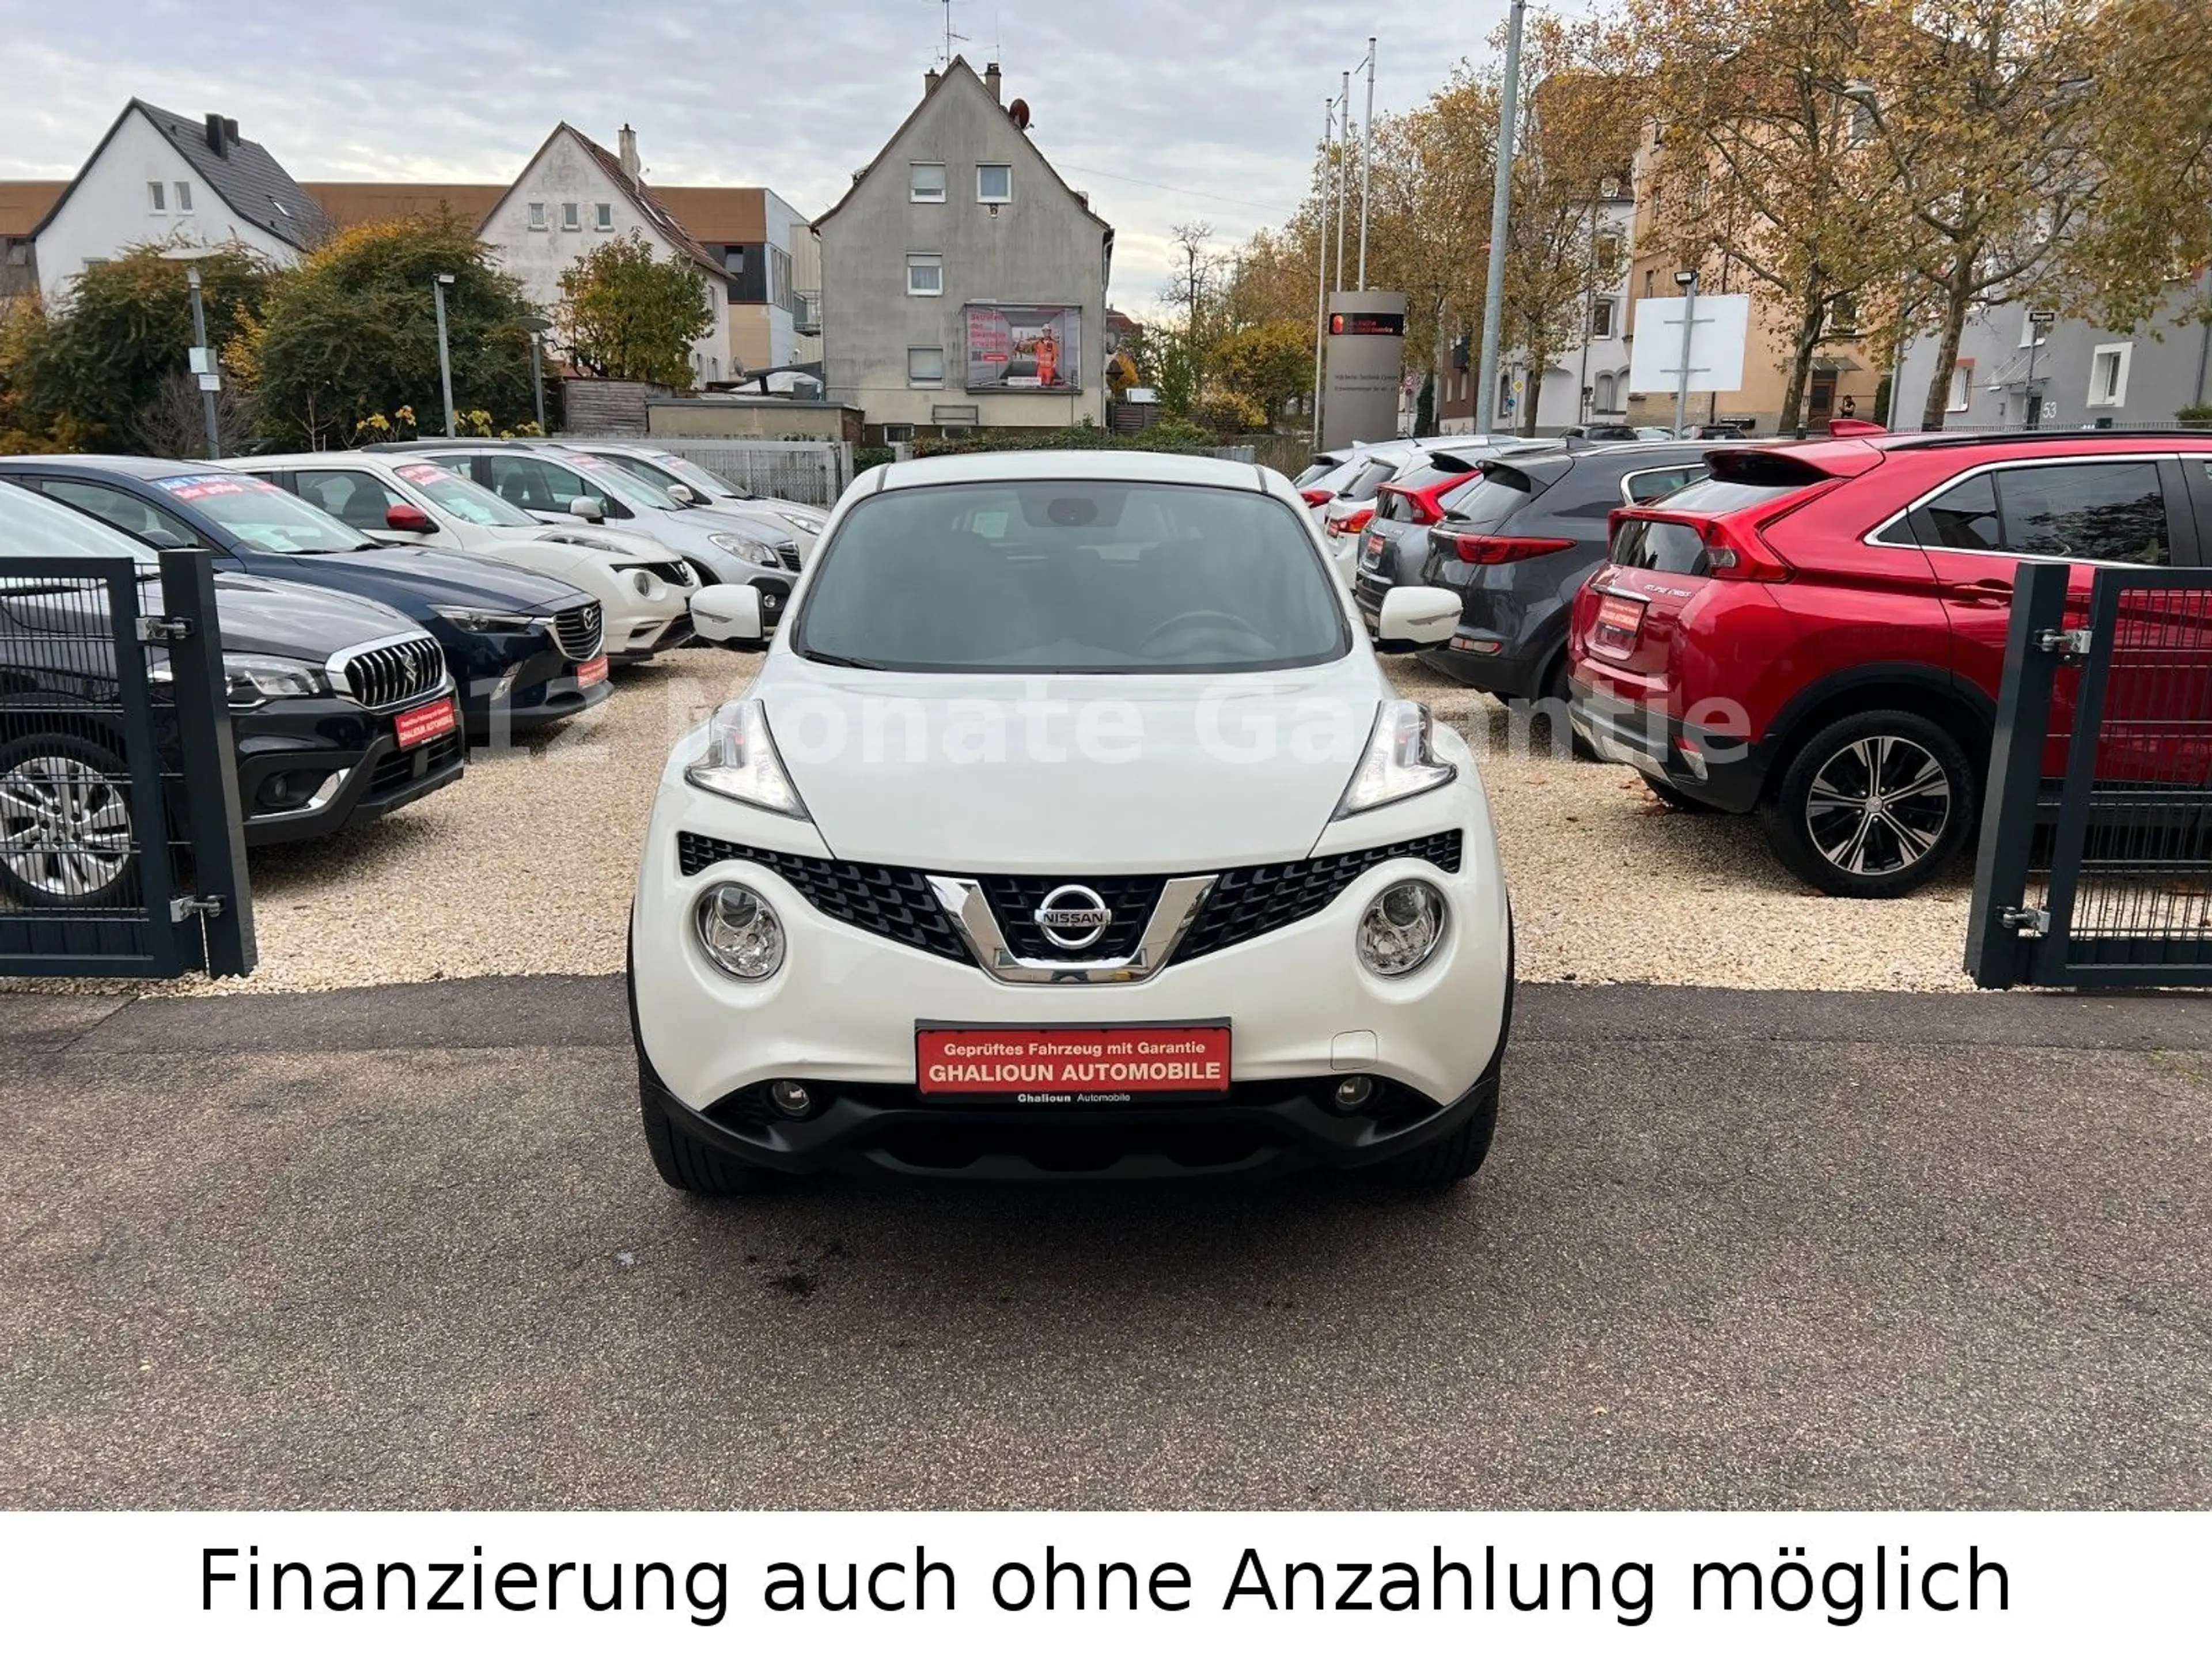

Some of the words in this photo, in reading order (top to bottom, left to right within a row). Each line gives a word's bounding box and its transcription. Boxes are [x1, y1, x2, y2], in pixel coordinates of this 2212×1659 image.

[1043, 913, 1103, 923] NISSAN
[944, 1043, 1024, 1058] Geprüftes
[1028, 1042, 1103, 1057] Fahrzeug
[1107, 1041, 1133, 1055] mit
[1137, 1040, 1206, 1055] Garantie
[928, 1064, 1054, 1082] GHALIOUN
[1060, 1062, 1221, 1082] AUTOMOBILE
[1017, 1093, 1072, 1103] Ghalioun
[1076, 1093, 1131, 1103] Automobile
